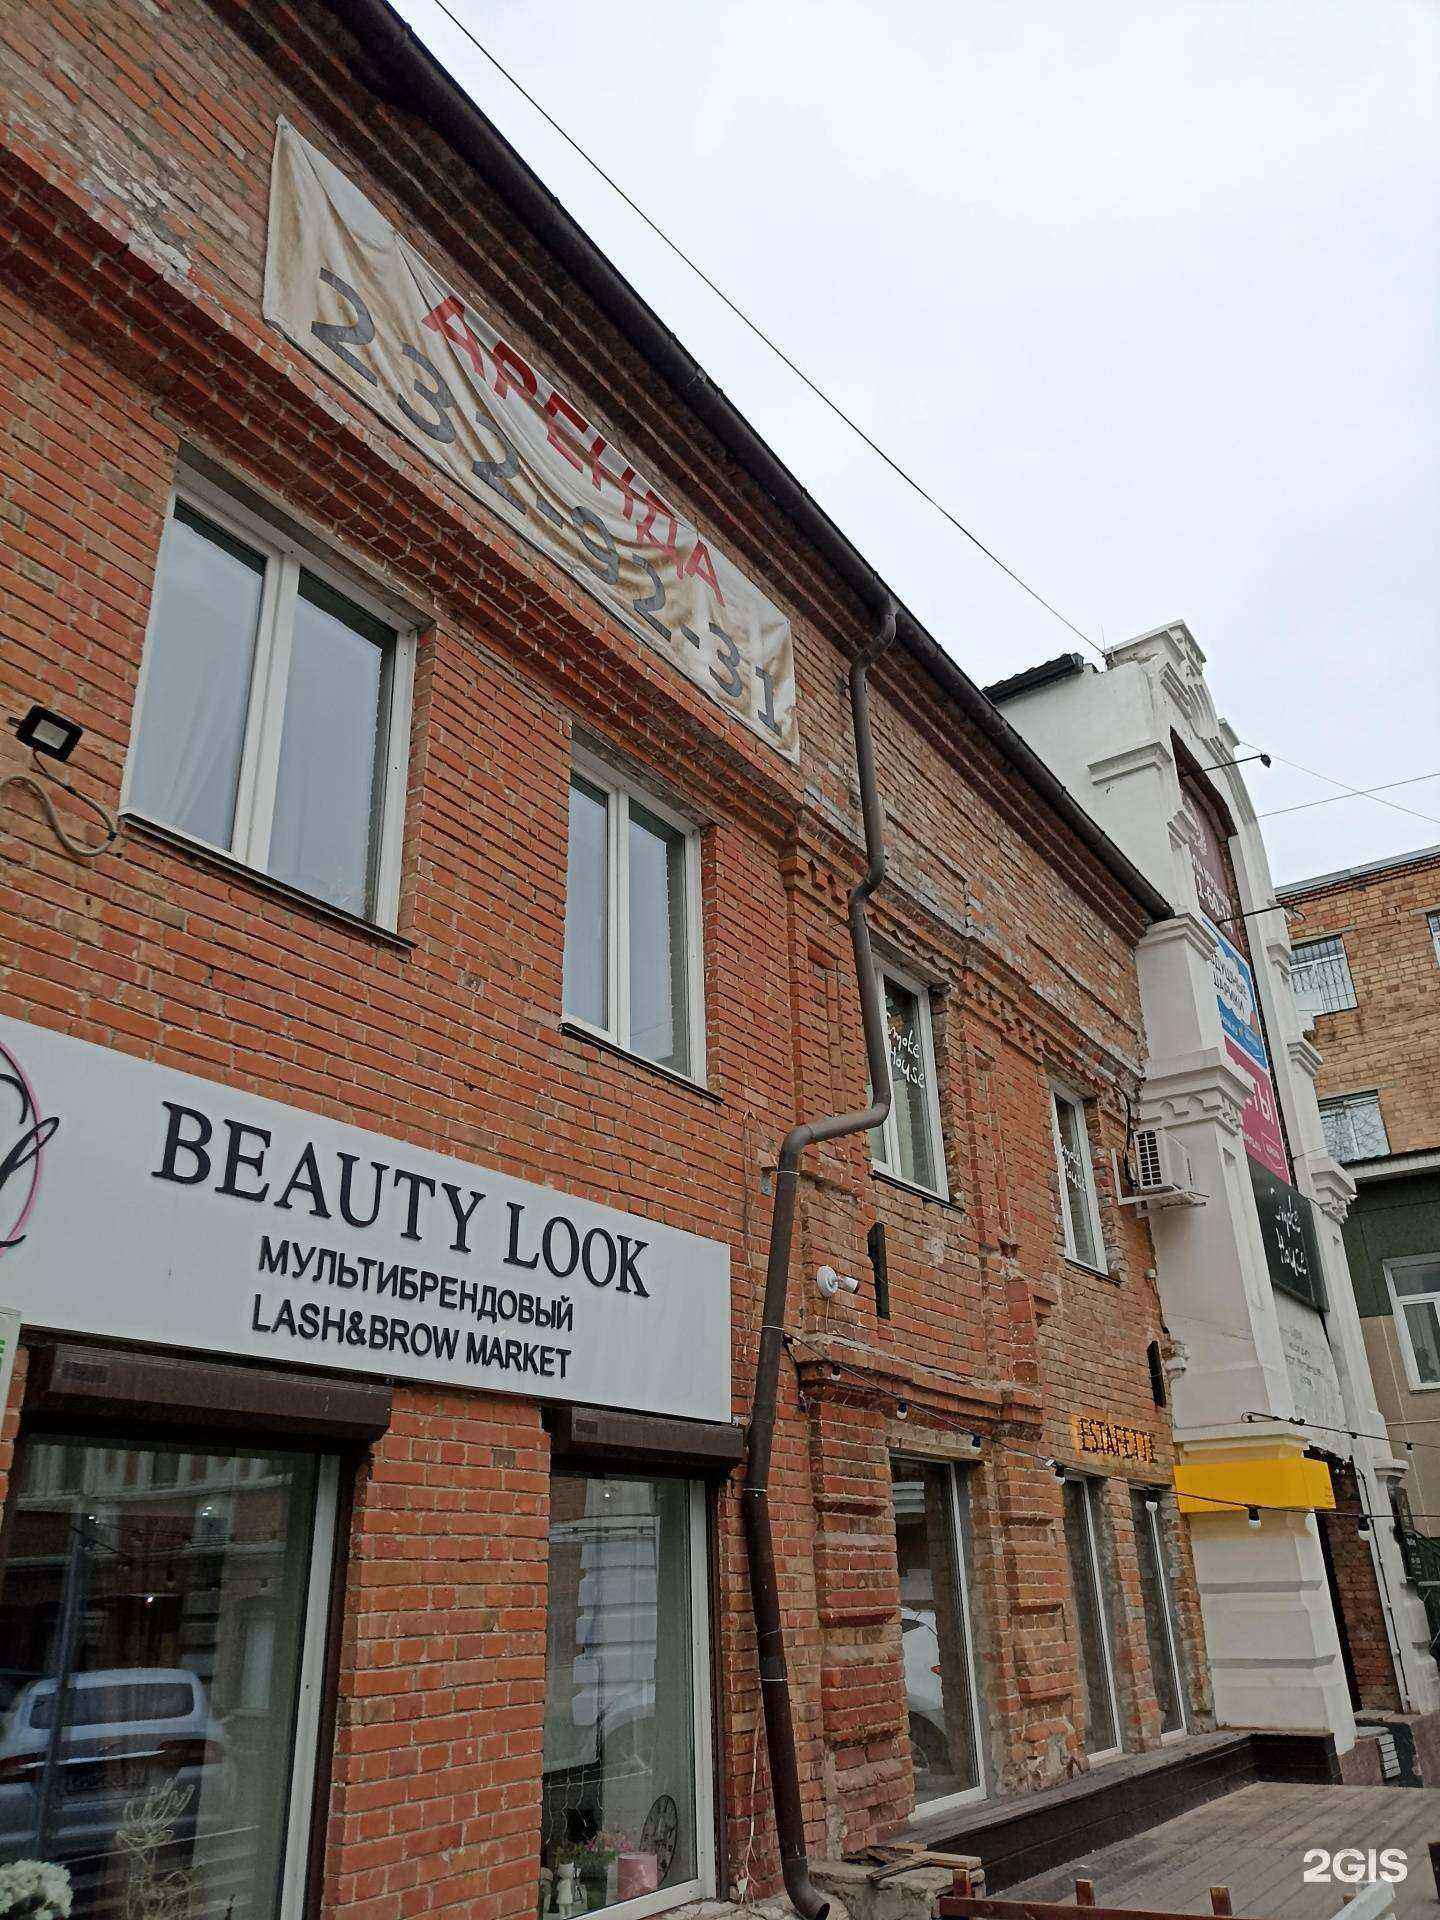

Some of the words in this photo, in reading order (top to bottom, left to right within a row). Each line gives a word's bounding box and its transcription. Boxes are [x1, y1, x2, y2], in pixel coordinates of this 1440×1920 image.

[311, 267, 782, 737] 232-92-31
[421, 295, 726, 607] АРЕНДА
[152, 1101, 486, 1253] BEAUTY
[503, 1201, 650, 1297] LOOK
[252, 1293, 460, 1360] LASH&BROW
[465, 1331, 572, 1379] MARKET
[258, 1235, 573, 1332] МУЛЬТИБРЕНДОВЫЙ
[1080, 1418, 1159, 1463] ESTAFETTE
